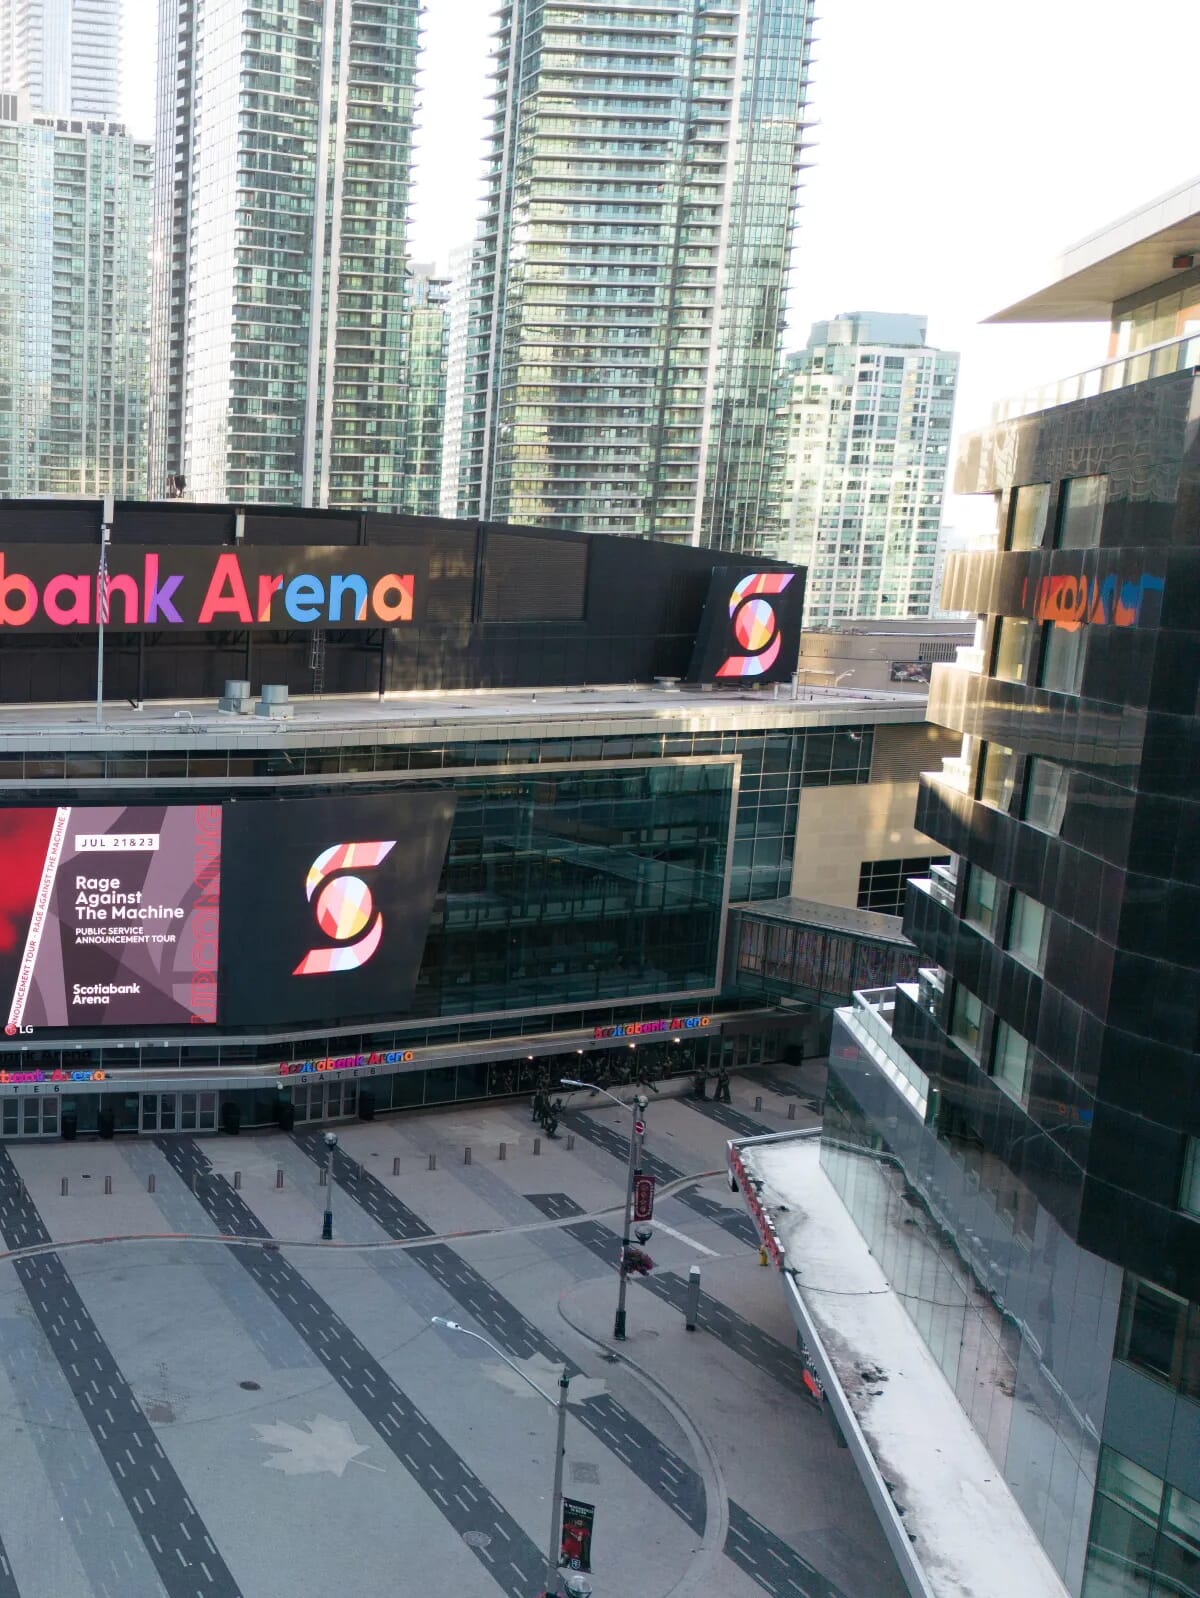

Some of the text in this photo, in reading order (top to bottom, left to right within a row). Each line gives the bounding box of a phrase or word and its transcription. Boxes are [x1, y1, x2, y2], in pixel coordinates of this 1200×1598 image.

[198, 552, 416, 624] Arena
[50, 816, 66, 855] MACHINE
[81, 838, 154, 847] JUL 21&23
[46, 856, 56, 873] THE
[37, 873, 53, 910] AGAINST
[75, 875, 121, 892] Rage
[74, 890, 143, 907] Against
[75, 905, 185, 920] The Machine
[191, 805, 222, 1024] UPCOMING
[107, 926, 144, 934] SERVICE
[75, 935, 176, 944] ANNOUNCEMENT TOUR
[25, 940, 37, 963] TOUR
[72, 983, 141, 995] Scotiabank
[72, 994, 110, 1005] Arena
[19, 1025, 34, 1034] LG
[593, 1016, 711, 1039] Scotiabank Arena
[279, 1050, 414, 1076] Scotiabank Arena
[50, 1068, 106, 1083] Arena
[301, 1069, 359, 1083] GATE
[54, 1085, 60, 1093] 6
